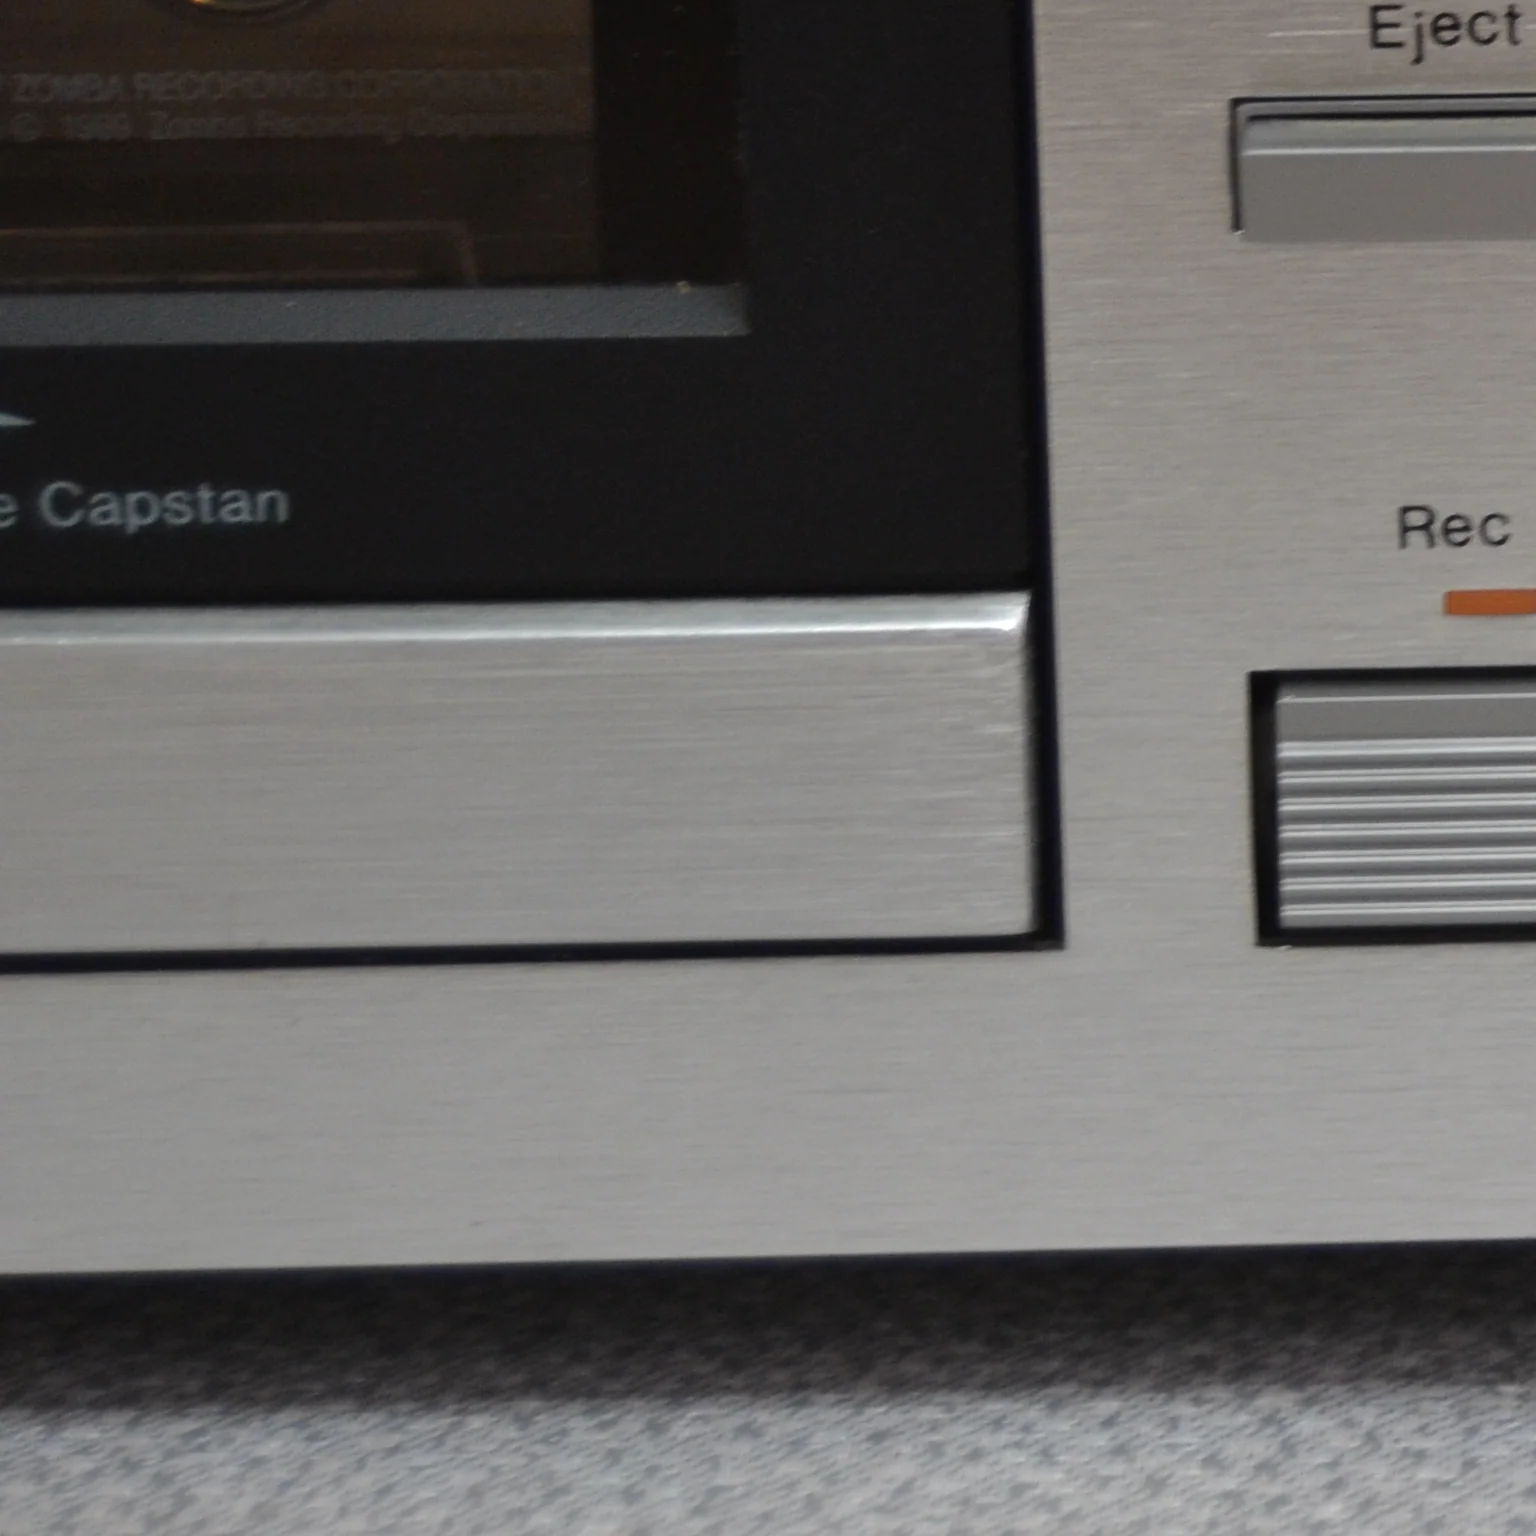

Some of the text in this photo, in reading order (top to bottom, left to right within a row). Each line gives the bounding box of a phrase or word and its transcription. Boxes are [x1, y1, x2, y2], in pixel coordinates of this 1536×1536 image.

[1369, 3, 1521, 66] Eject
[38, 480, 288, 534] Capstan
[1398, 504, 1510, 548] Rec
